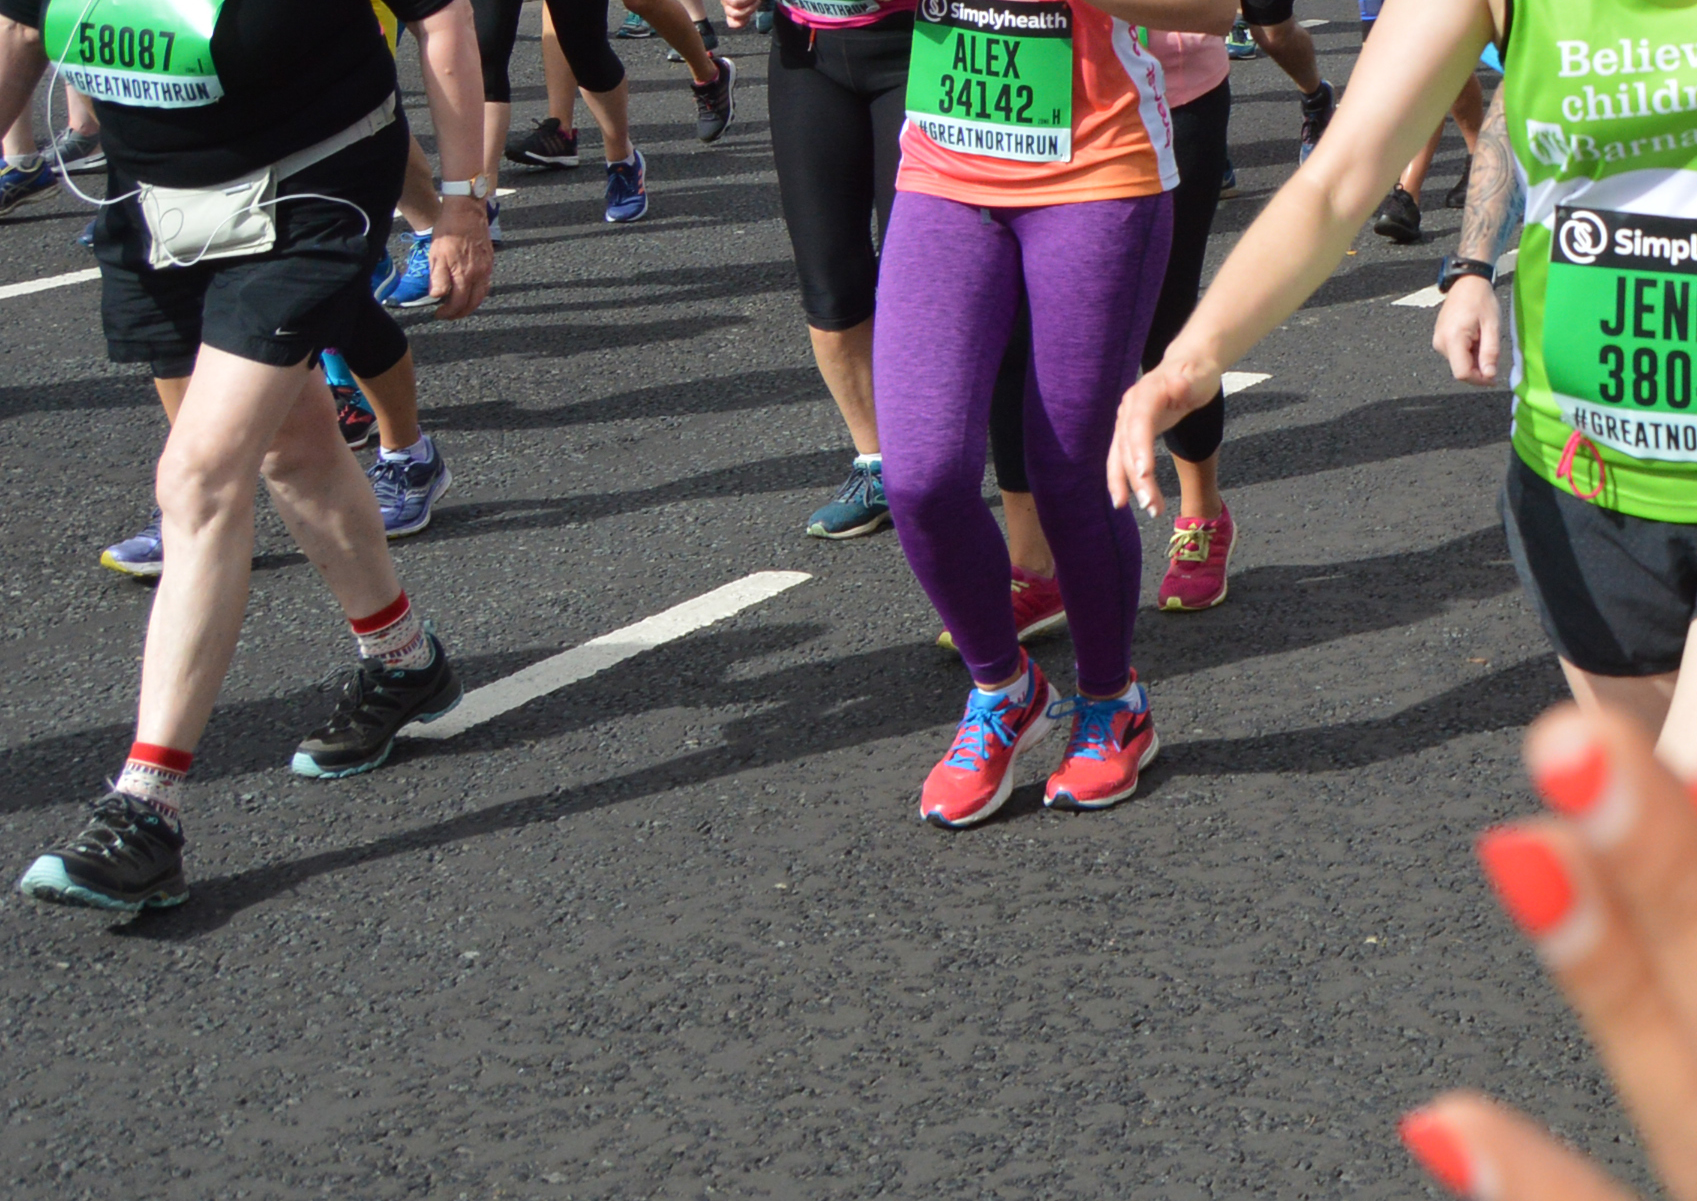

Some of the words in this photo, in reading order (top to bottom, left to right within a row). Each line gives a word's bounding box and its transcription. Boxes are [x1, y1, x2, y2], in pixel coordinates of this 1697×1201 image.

[950, 2, 1068, 31] Simplyhealth
[79, 21, 177, 73] 58087
[952, 32, 1022, 81] ALEX
[65, 69, 212, 103] #GREATNORTHRUN
[938, 73, 1034, 124] 34142
[1052, 108, 1061, 125] H
[918, 119, 1060, 157] #GREATNORTHRUN
